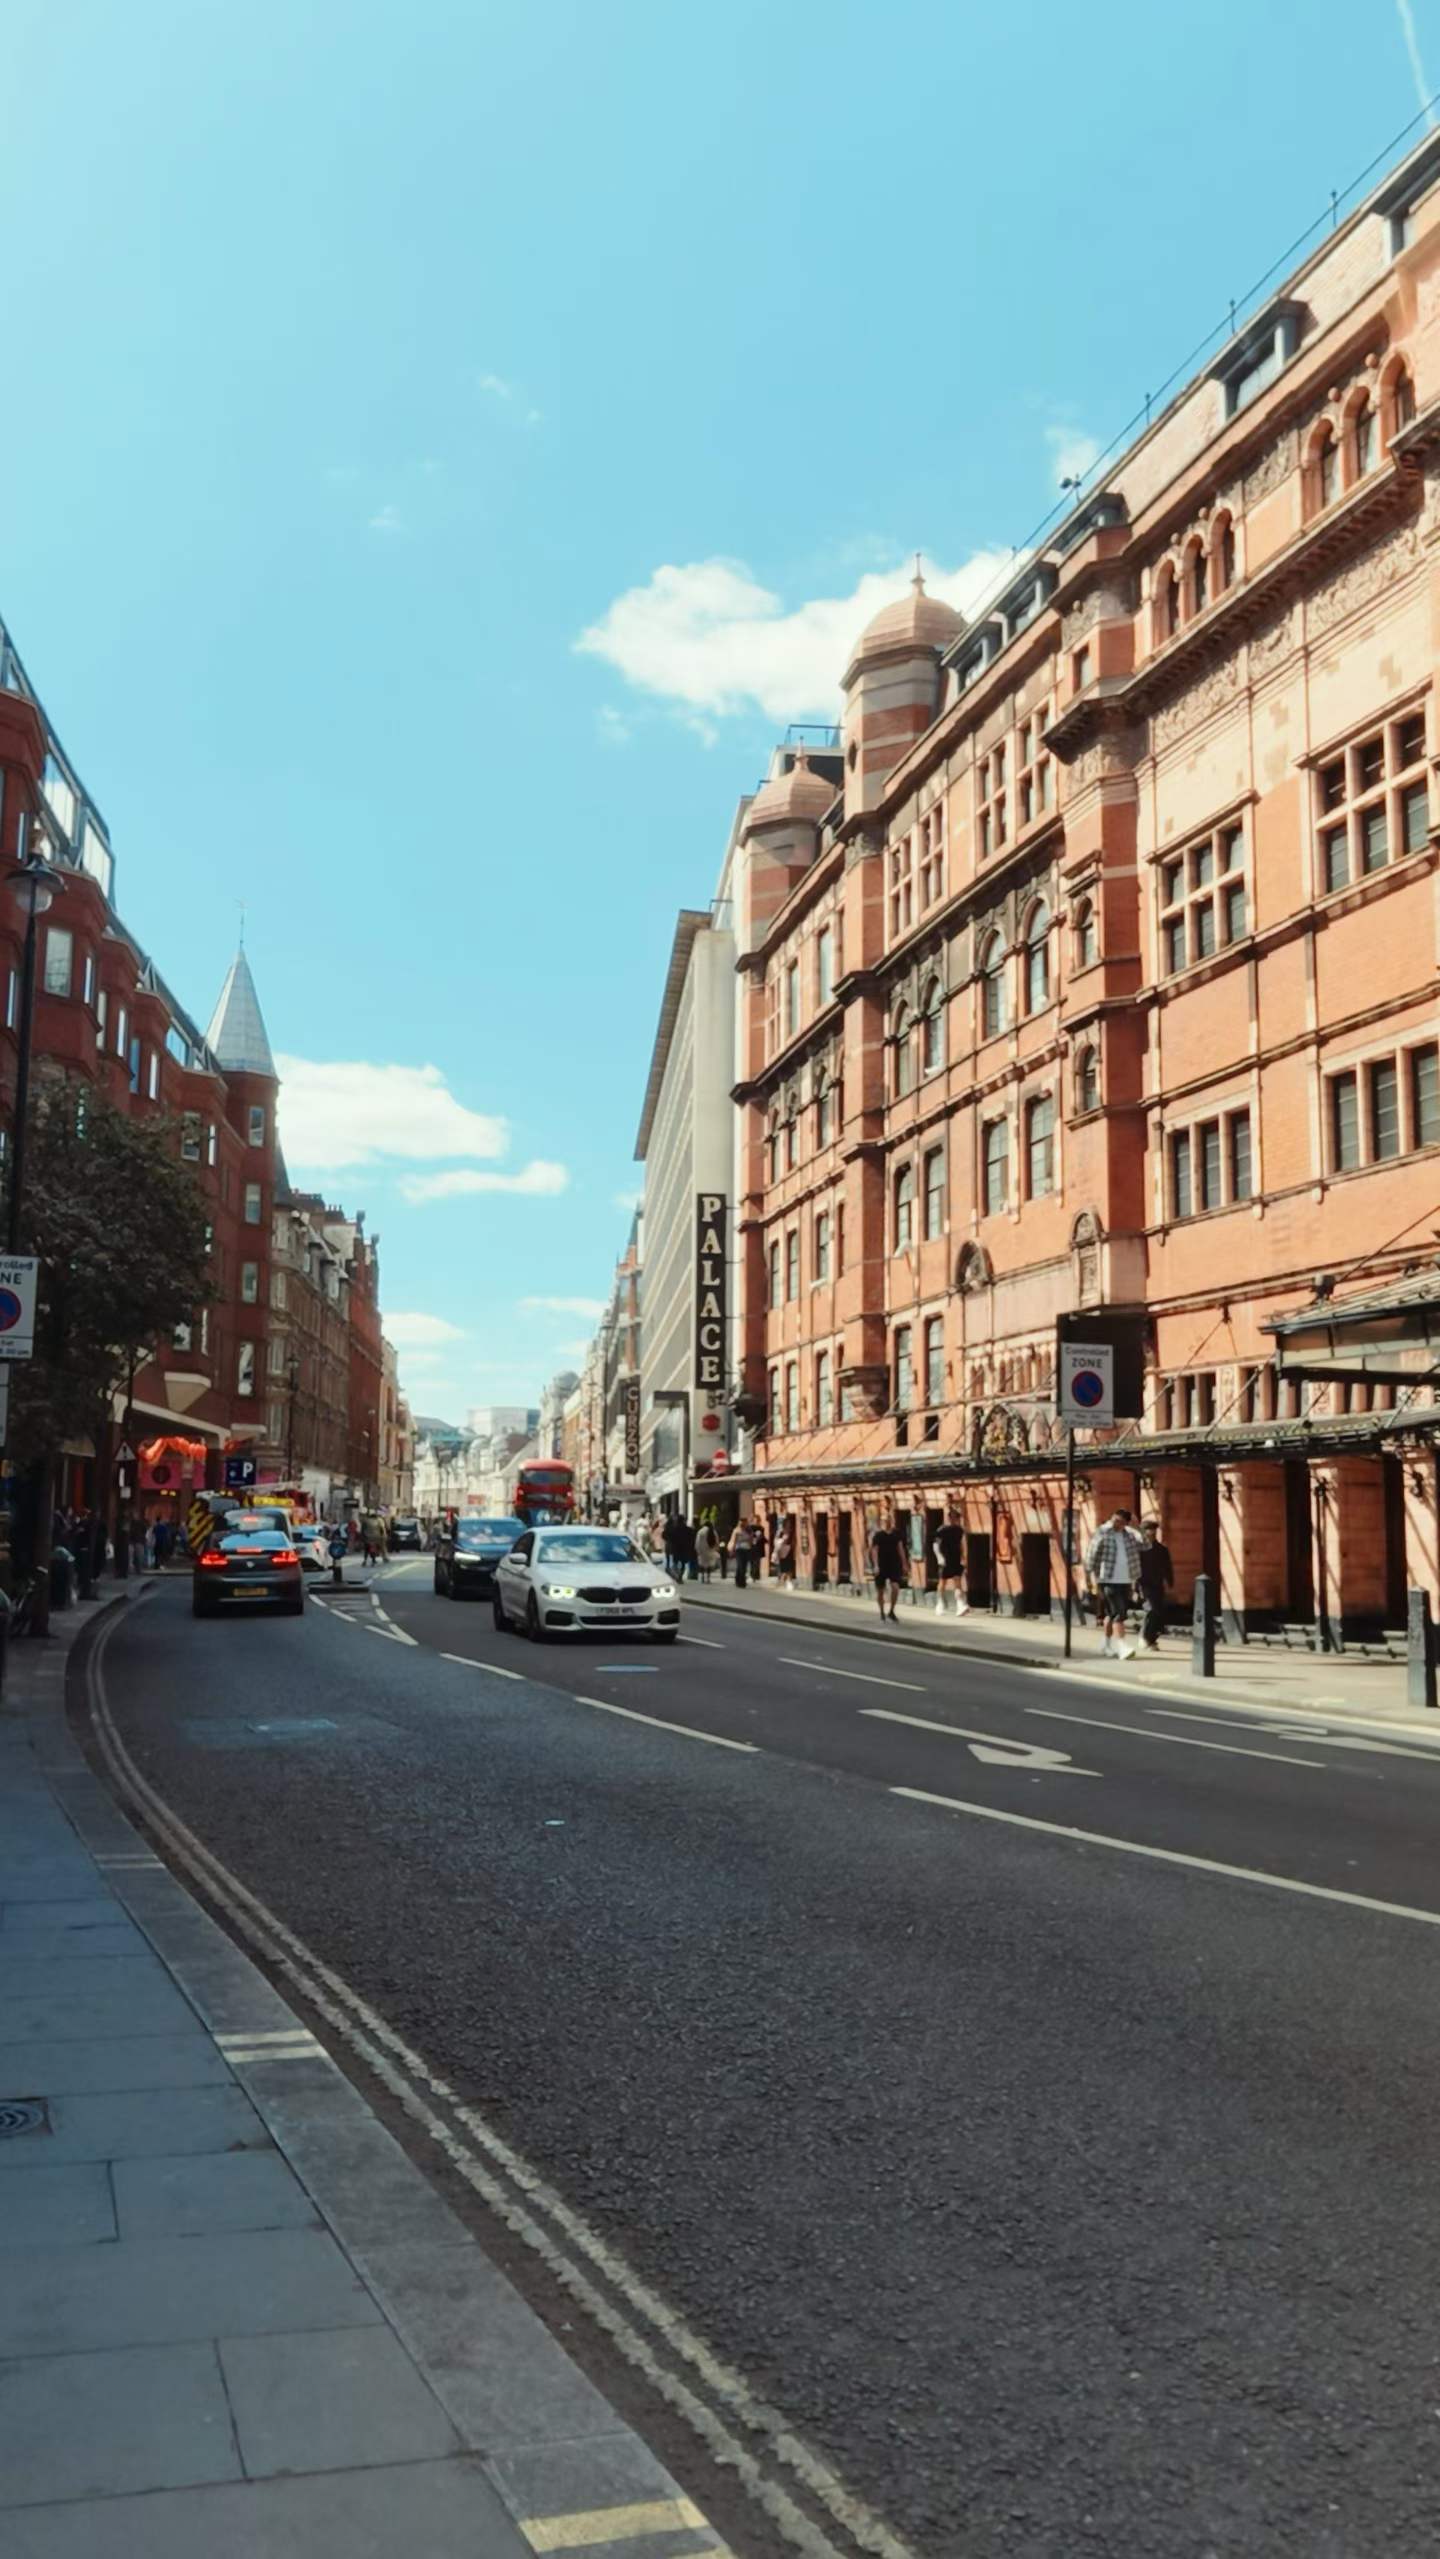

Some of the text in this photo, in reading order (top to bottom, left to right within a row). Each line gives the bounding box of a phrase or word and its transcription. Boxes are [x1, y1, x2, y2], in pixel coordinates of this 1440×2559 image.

[700, 1196, 722, 1383] PALACE
[1072, 1358, 1103, 1368] ZONE
[626, 1386, 640, 1470] CURZON
[243, 1462, 253, 1478] P
